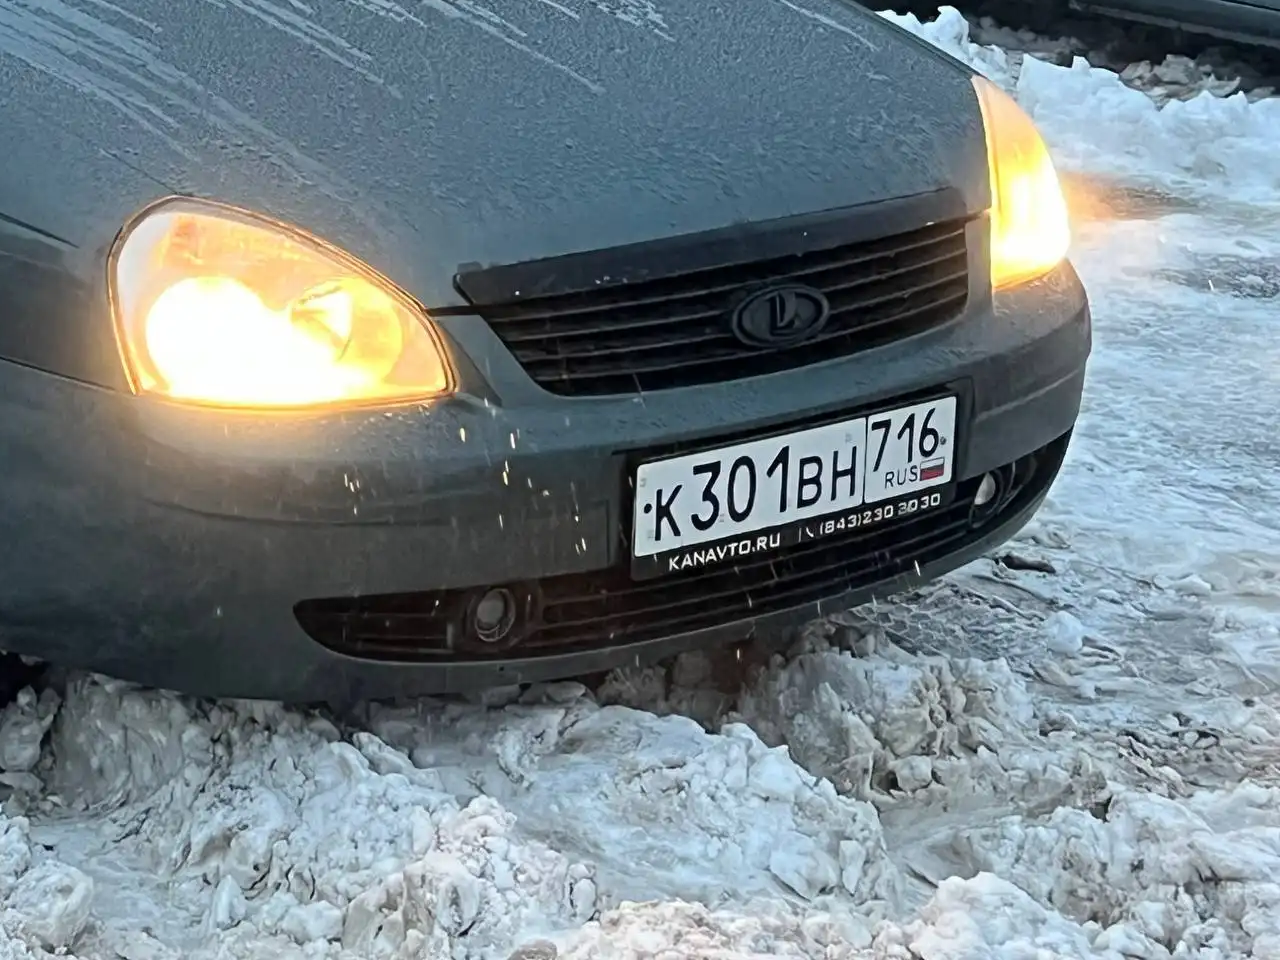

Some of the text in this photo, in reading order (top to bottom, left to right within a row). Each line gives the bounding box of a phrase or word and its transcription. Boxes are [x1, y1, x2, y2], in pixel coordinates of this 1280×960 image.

[653, 407, 939, 541] К301ВН 716
[885, 465, 918, 489] RUS
[668, 532, 780, 572] KANAVTO.RU
